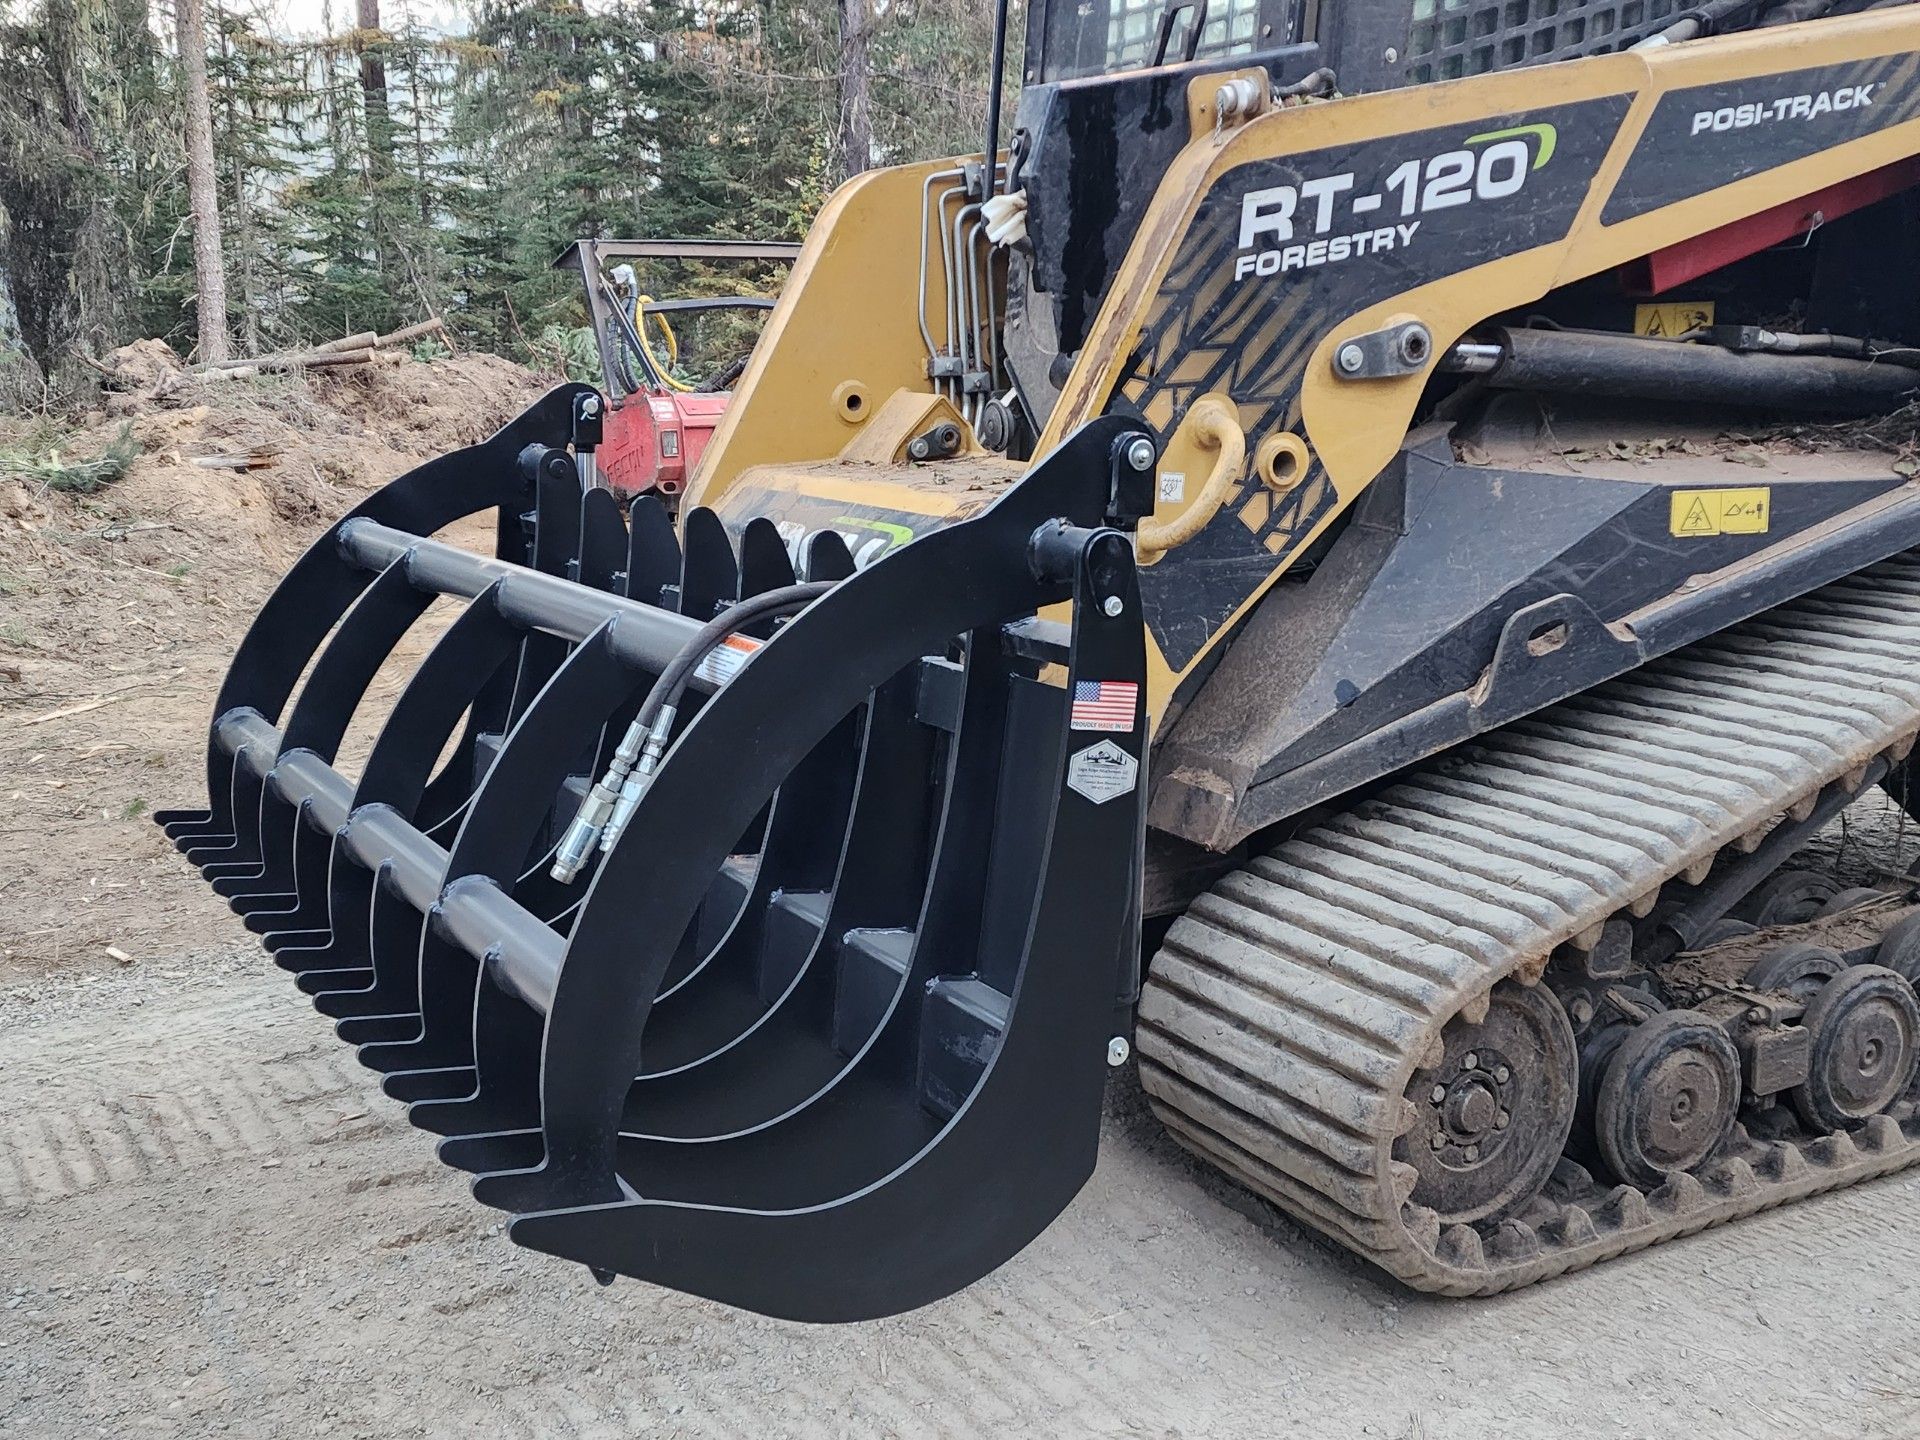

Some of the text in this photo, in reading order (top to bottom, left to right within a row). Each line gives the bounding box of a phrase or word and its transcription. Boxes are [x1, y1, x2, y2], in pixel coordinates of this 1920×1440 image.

[1690, 82, 1875, 137] POSI-TRACK
[1238, 140, 1529, 250] RT-120
[1234, 220, 1422, 282] FORESTRY
[1072, 720, 1097, 728] PROUDLY
